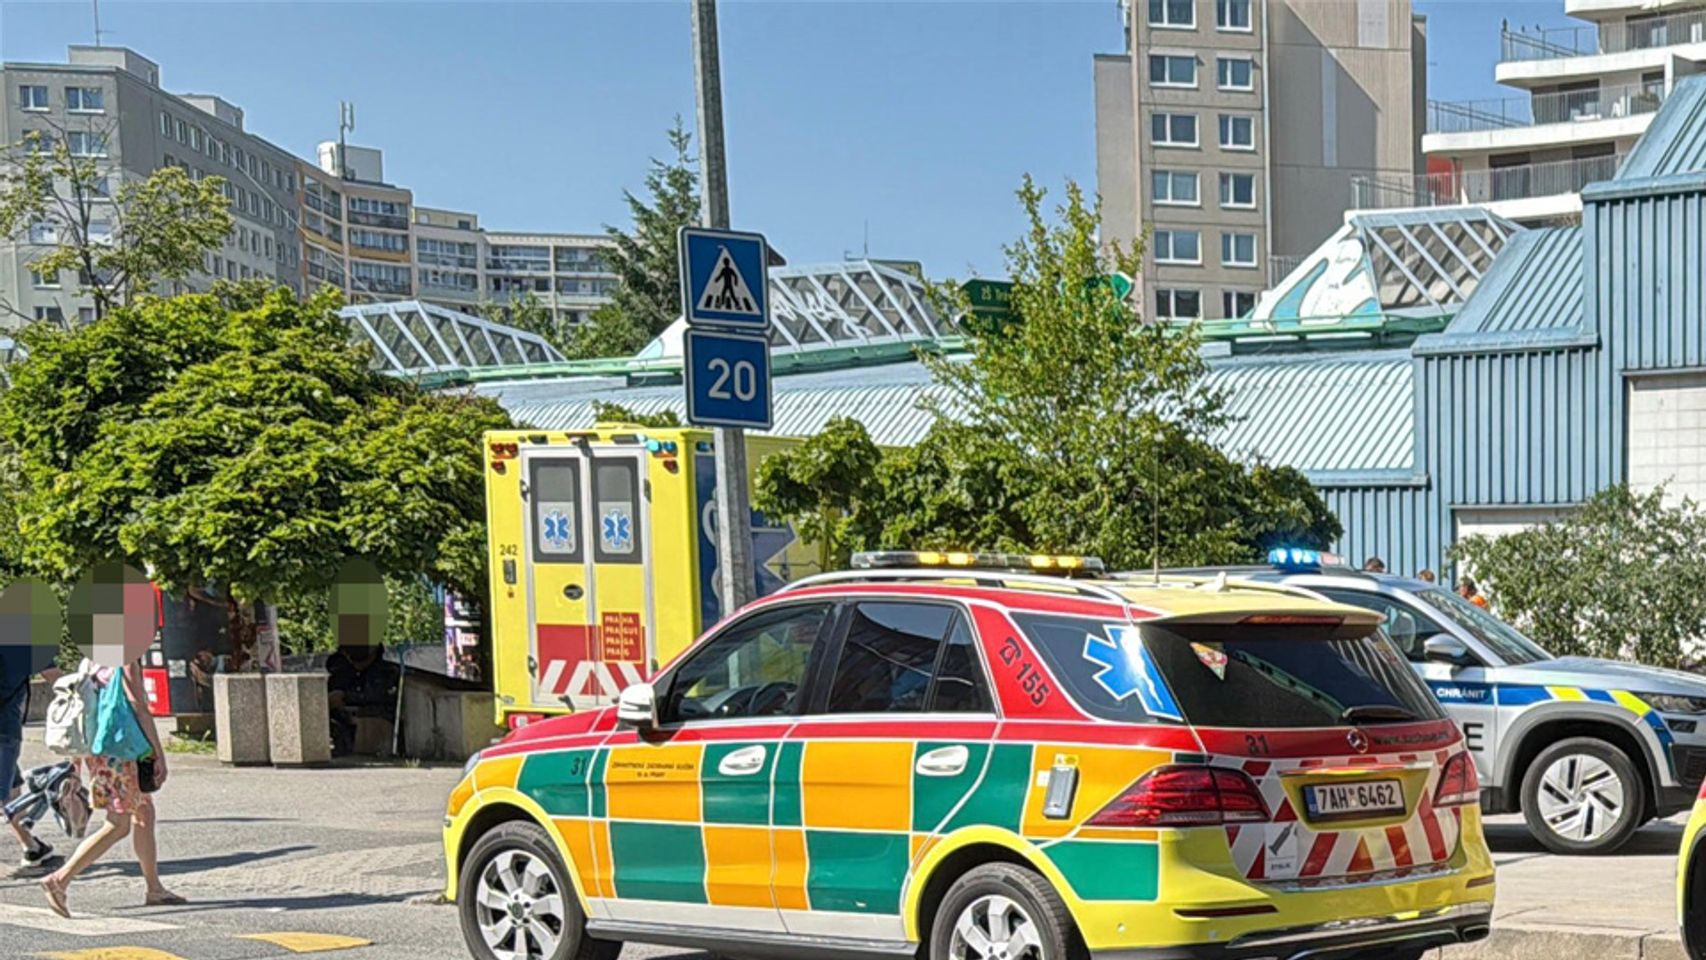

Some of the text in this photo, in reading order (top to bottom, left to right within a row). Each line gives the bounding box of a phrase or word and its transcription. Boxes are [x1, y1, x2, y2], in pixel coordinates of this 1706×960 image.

[707, 357, 757, 401] 20
[499, 544, 518, 556] 242
[1016, 662, 1050, 705] 155
[570, 757, 587, 777] 31
[1318, 783, 1397, 811] 7AH 6462
